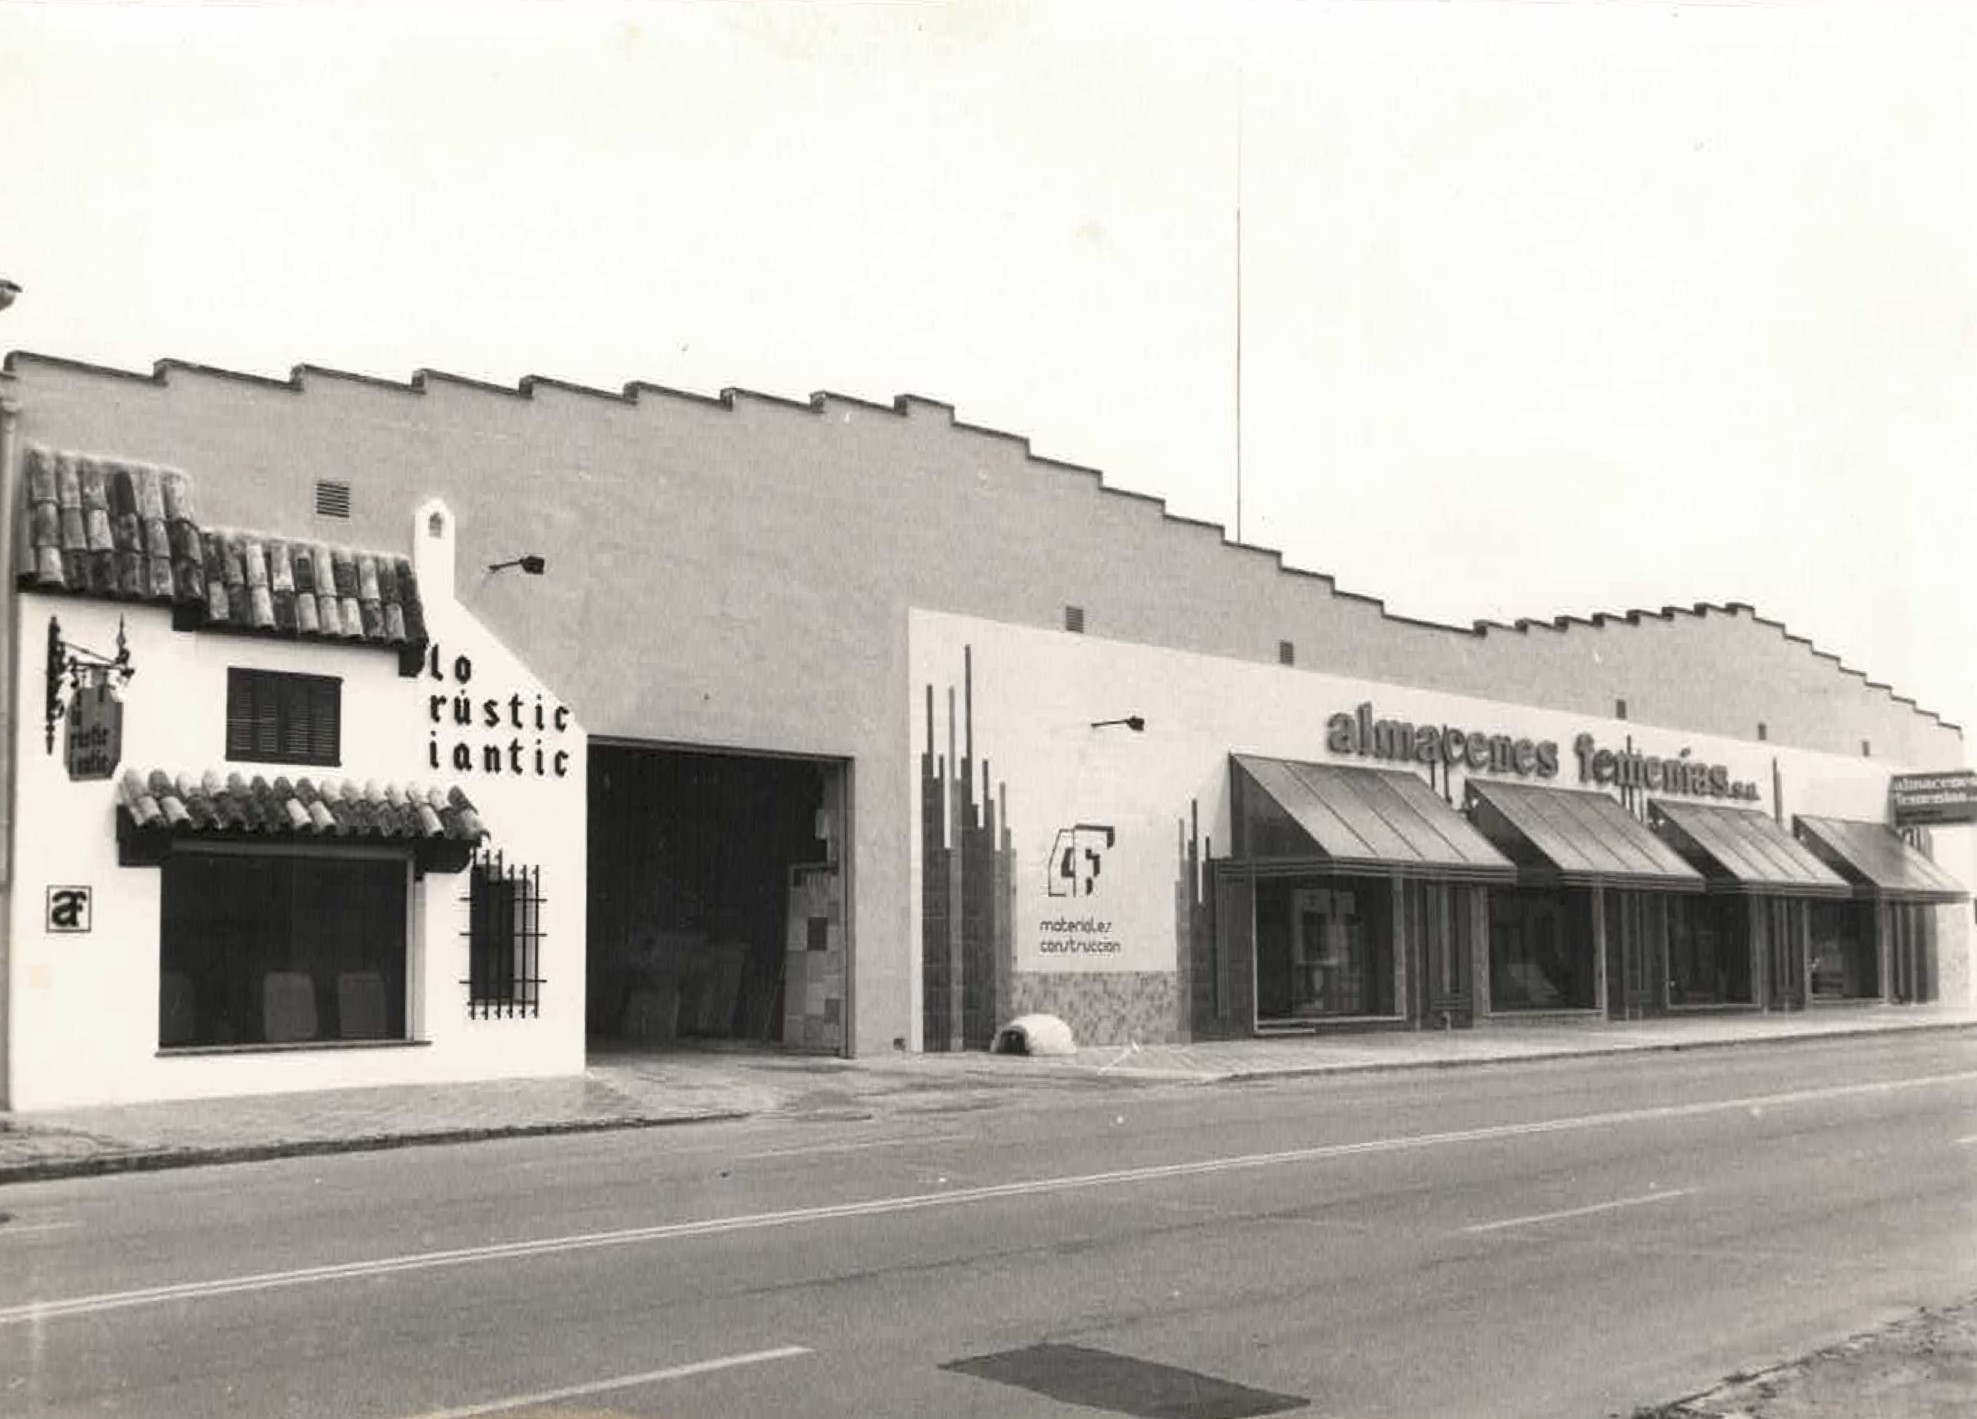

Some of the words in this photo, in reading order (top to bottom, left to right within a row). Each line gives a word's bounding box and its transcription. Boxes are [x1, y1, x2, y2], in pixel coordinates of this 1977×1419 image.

[430, 643, 472, 684] lo
[430, 689, 569, 732] rústic
[429, 730, 569, 776] iantic
[1327, 702, 1559, 779] almacenes
[1039, 915, 1113, 933] materiales
